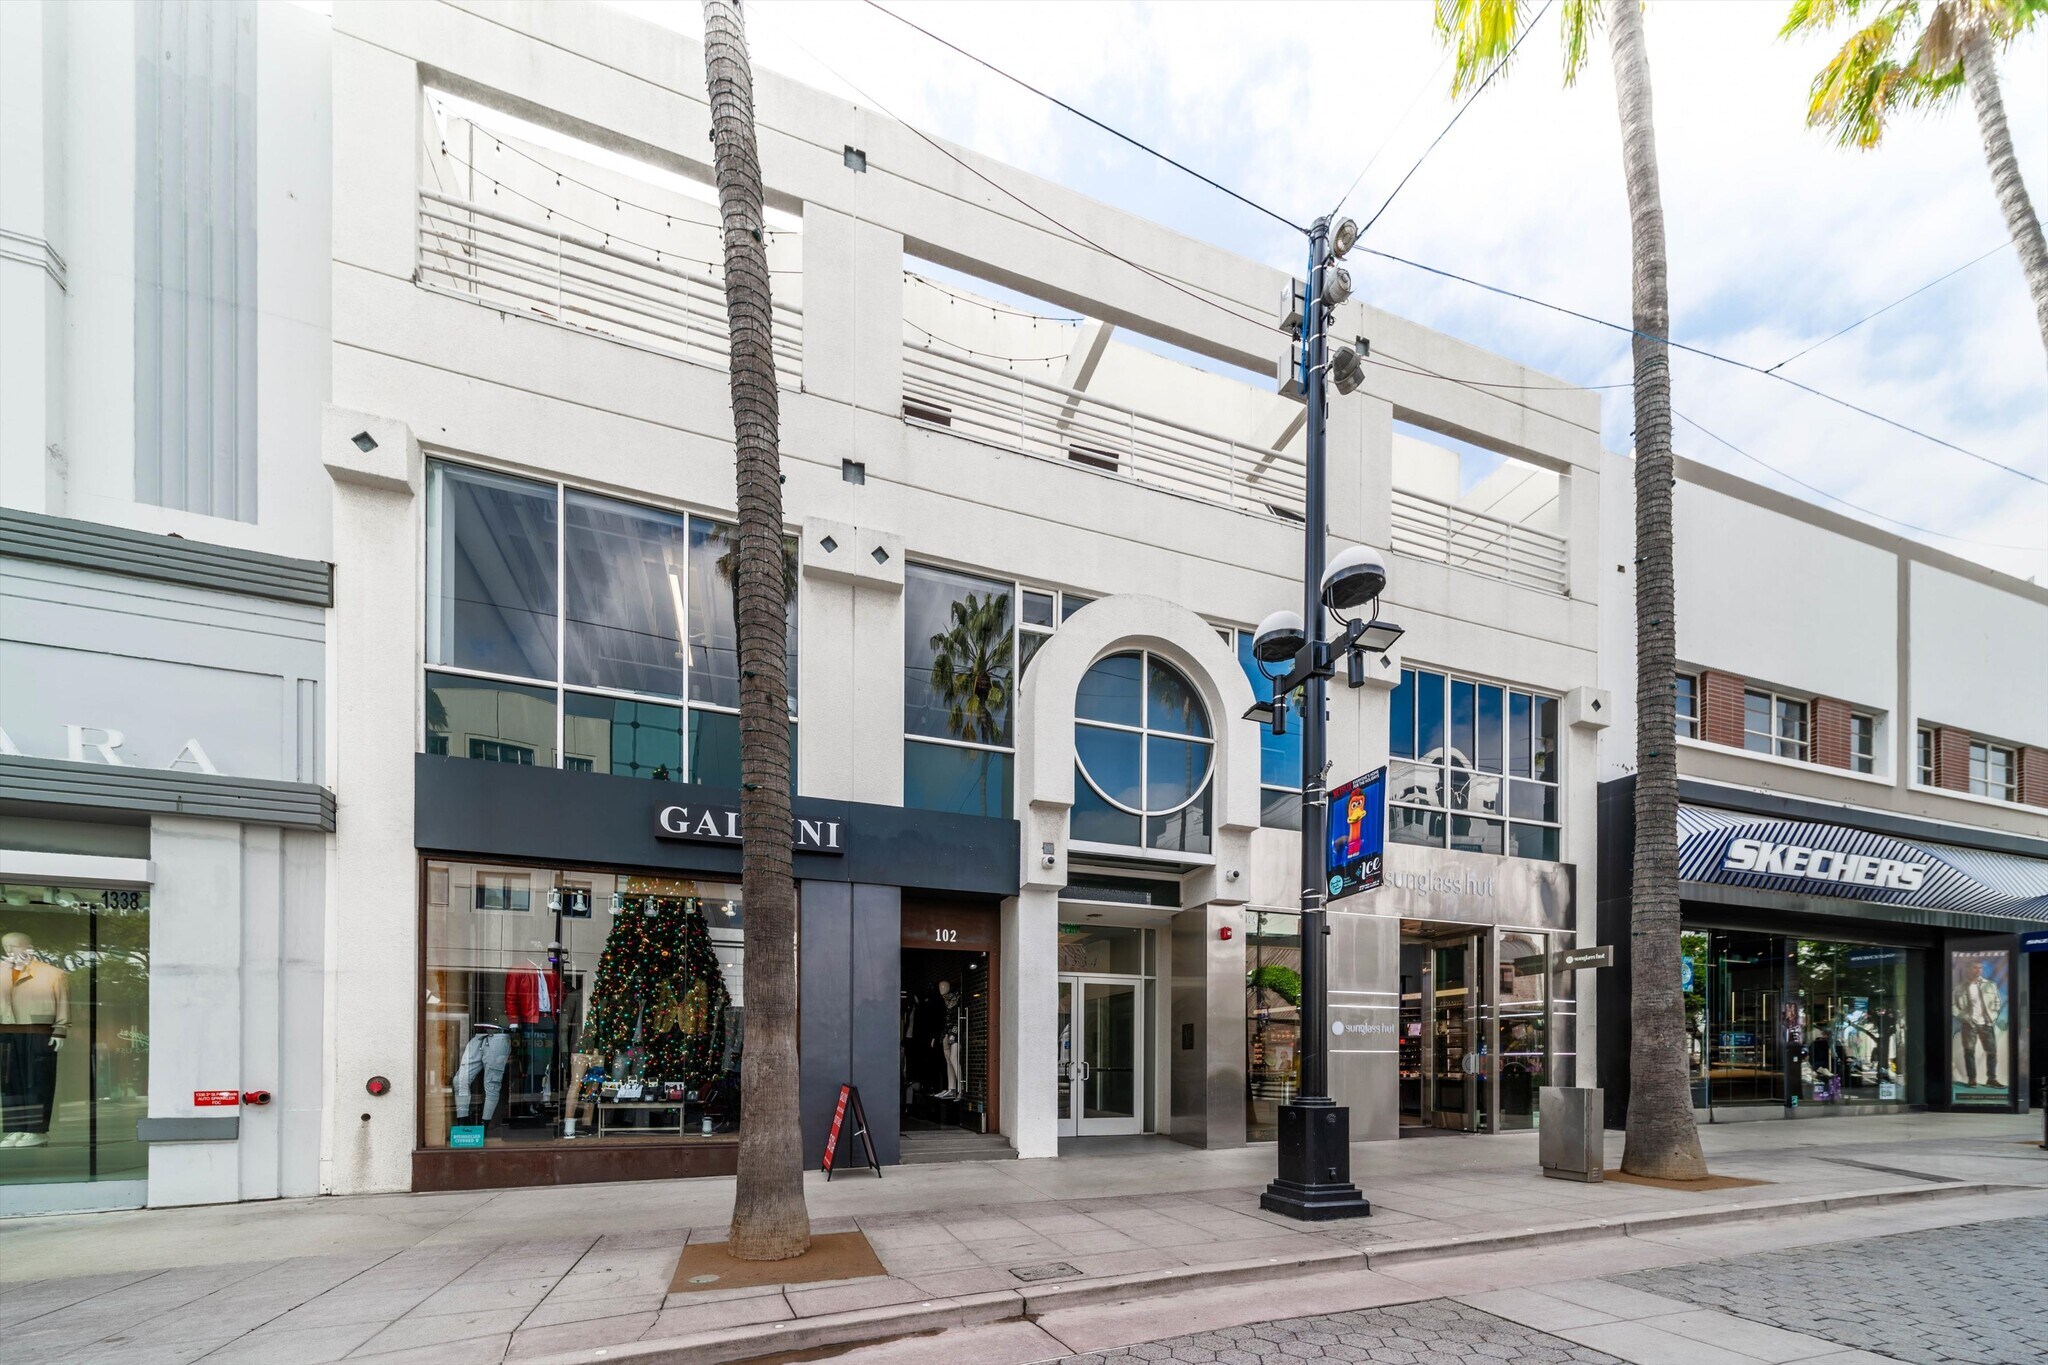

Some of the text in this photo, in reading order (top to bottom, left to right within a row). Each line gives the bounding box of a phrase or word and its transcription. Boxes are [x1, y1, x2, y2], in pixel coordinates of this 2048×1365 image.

[660, 805, 840, 848] GALNI
[1724, 837, 1926, 891] SKECHERS
[1383, 868, 1461, 897] sunglass
[1465, 871, 1495, 897] hut
[101, 890, 140, 910] 1338
[935, 928, 957, 943] 102
[1345, 1022, 1395, 1035] sunglass hut
